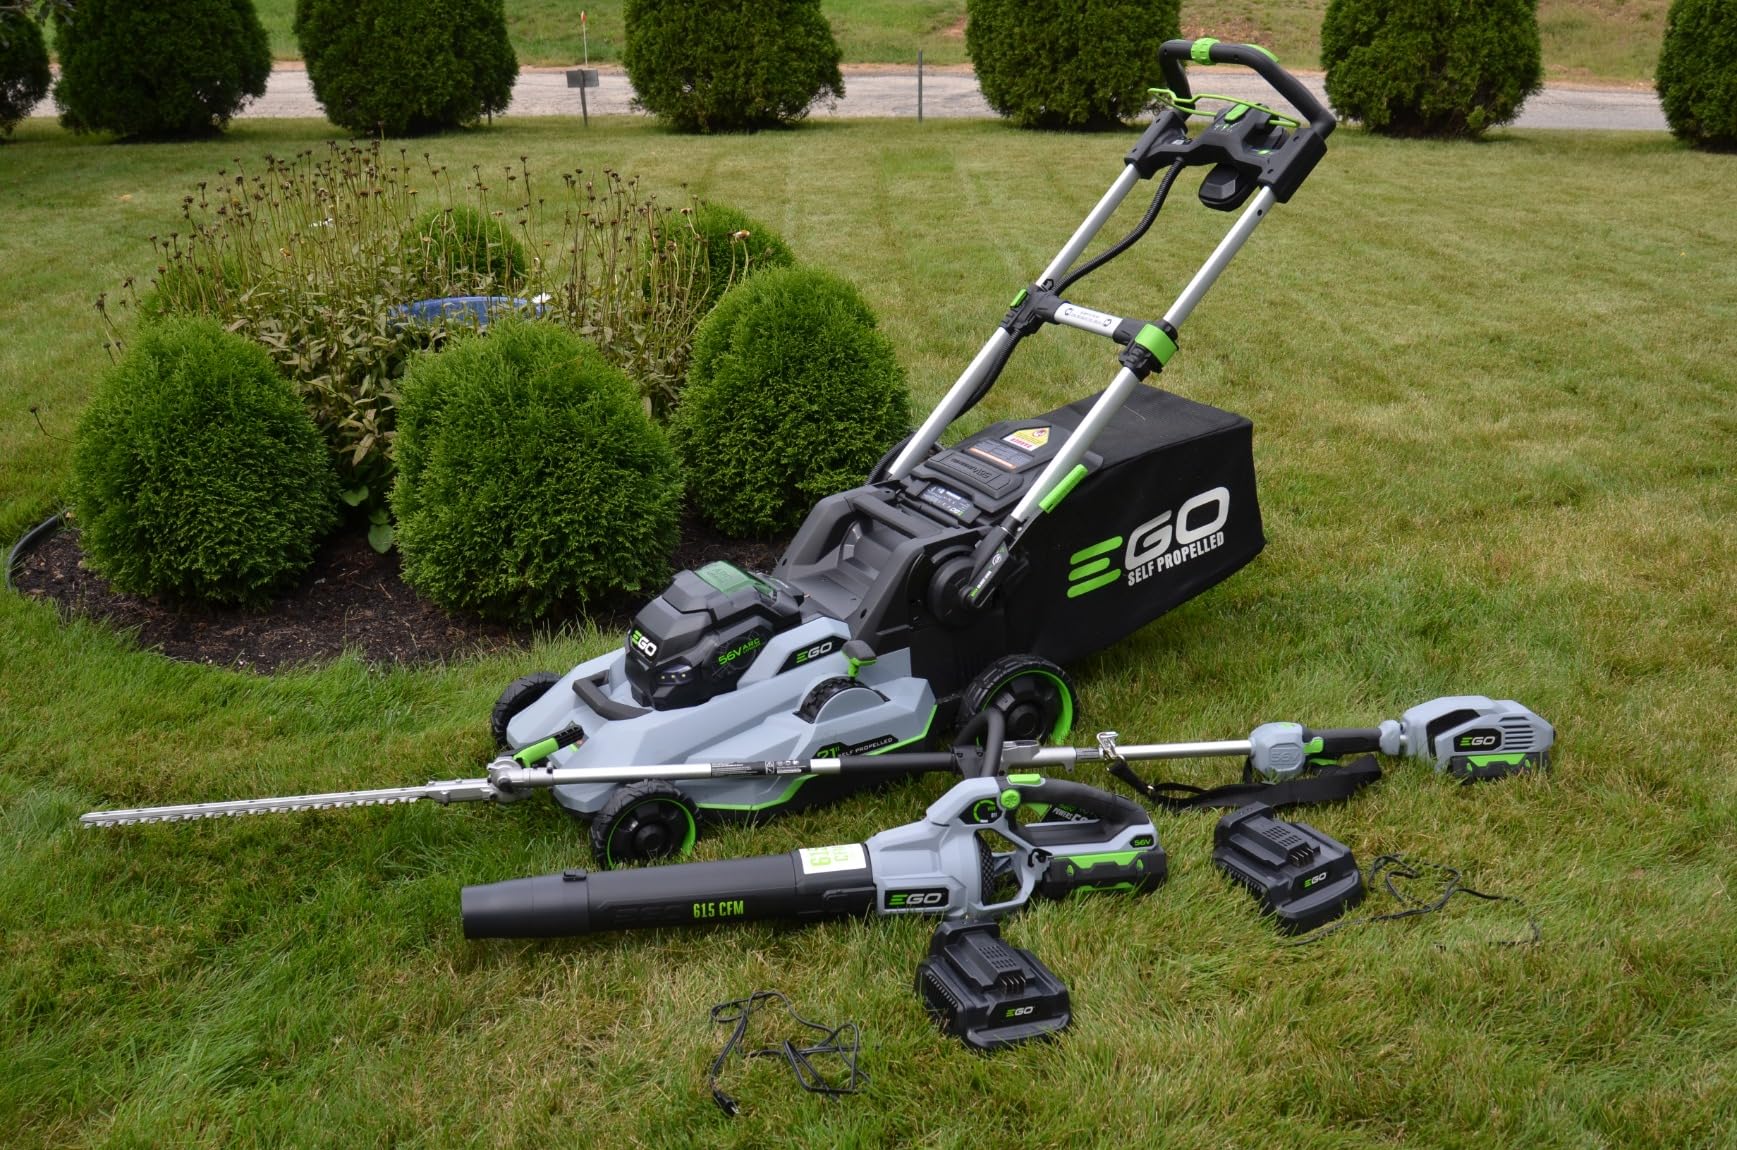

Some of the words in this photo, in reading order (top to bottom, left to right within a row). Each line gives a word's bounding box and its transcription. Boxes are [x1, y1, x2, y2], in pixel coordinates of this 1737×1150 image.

[1066, 486, 1230, 599] EGO
[1127, 561, 1155, 587] SELF
[1157, 531, 1225, 573] PROPELLED
[631, 629, 657, 657] EGO
[718, 644, 744, 666] 56V
[796, 641, 833, 664] EGO
[855, 737, 893, 753] PROPELLED
[1460, 736, 1496, 746] EGO
[1304, 871, 1328, 888] EGO
[889, 892, 943, 906] EGO
[693, 902, 716, 918] 615
[719, 900, 744, 917] CFM
[1006, 1006, 1034, 1018] EGO
